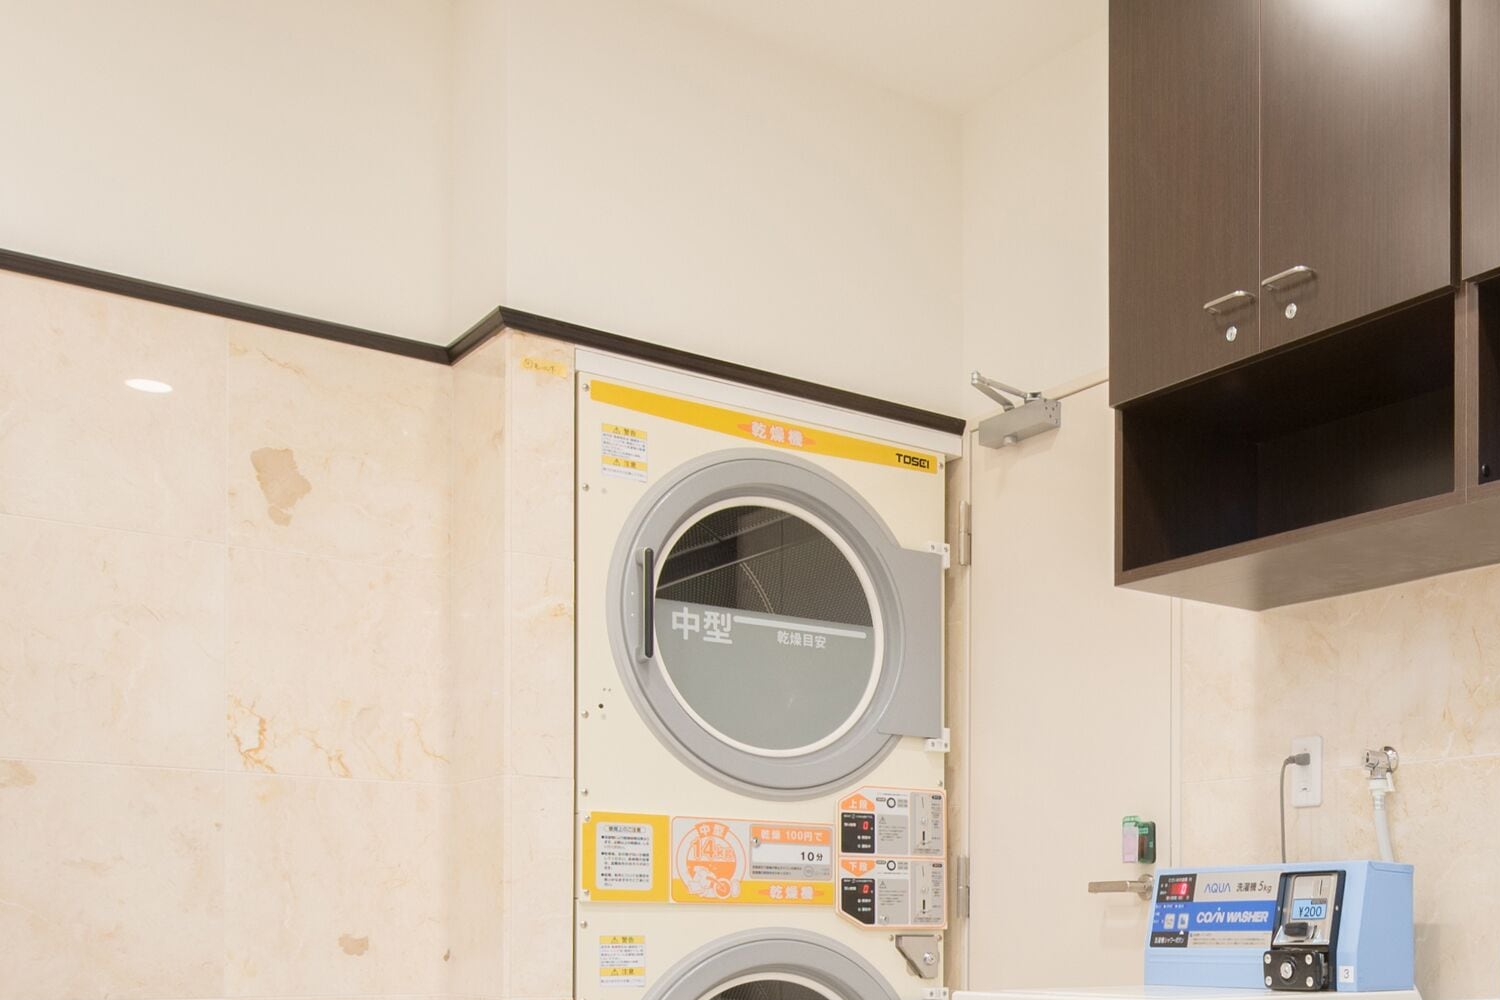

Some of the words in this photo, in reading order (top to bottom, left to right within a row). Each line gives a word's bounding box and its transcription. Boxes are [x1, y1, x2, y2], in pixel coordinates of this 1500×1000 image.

[895, 453, 930, 469] TOSEI
[671, 606, 733, 645] 中型
[777, 630, 827, 649] 乾燥目安
[800, 850, 824, 862] 10分
[1204, 882, 1231, 894] AQUA
[1226, 911, 1269, 923] WASHER
[1343, 968, 1351, 979] 3
